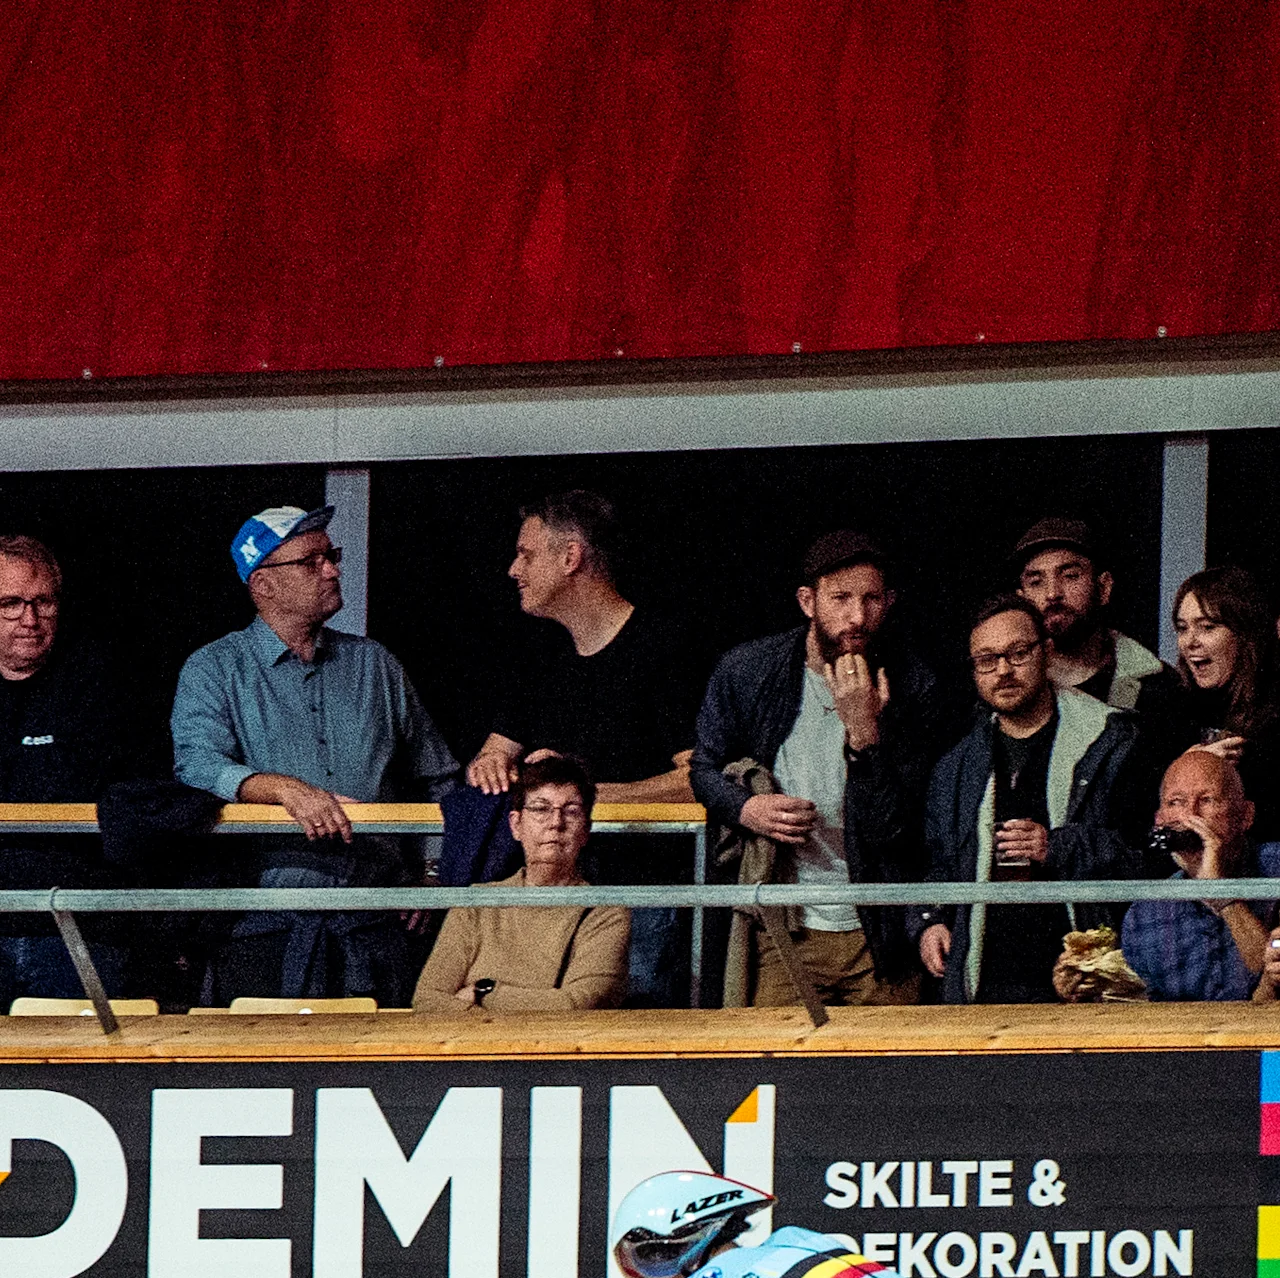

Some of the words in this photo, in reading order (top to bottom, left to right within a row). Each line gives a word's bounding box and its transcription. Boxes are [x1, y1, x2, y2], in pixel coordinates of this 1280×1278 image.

[823, 1160, 1014, 1209] SKILTE
[1027, 1159, 1067, 1207] &
[671, 1189, 744, 1224] LAZER
